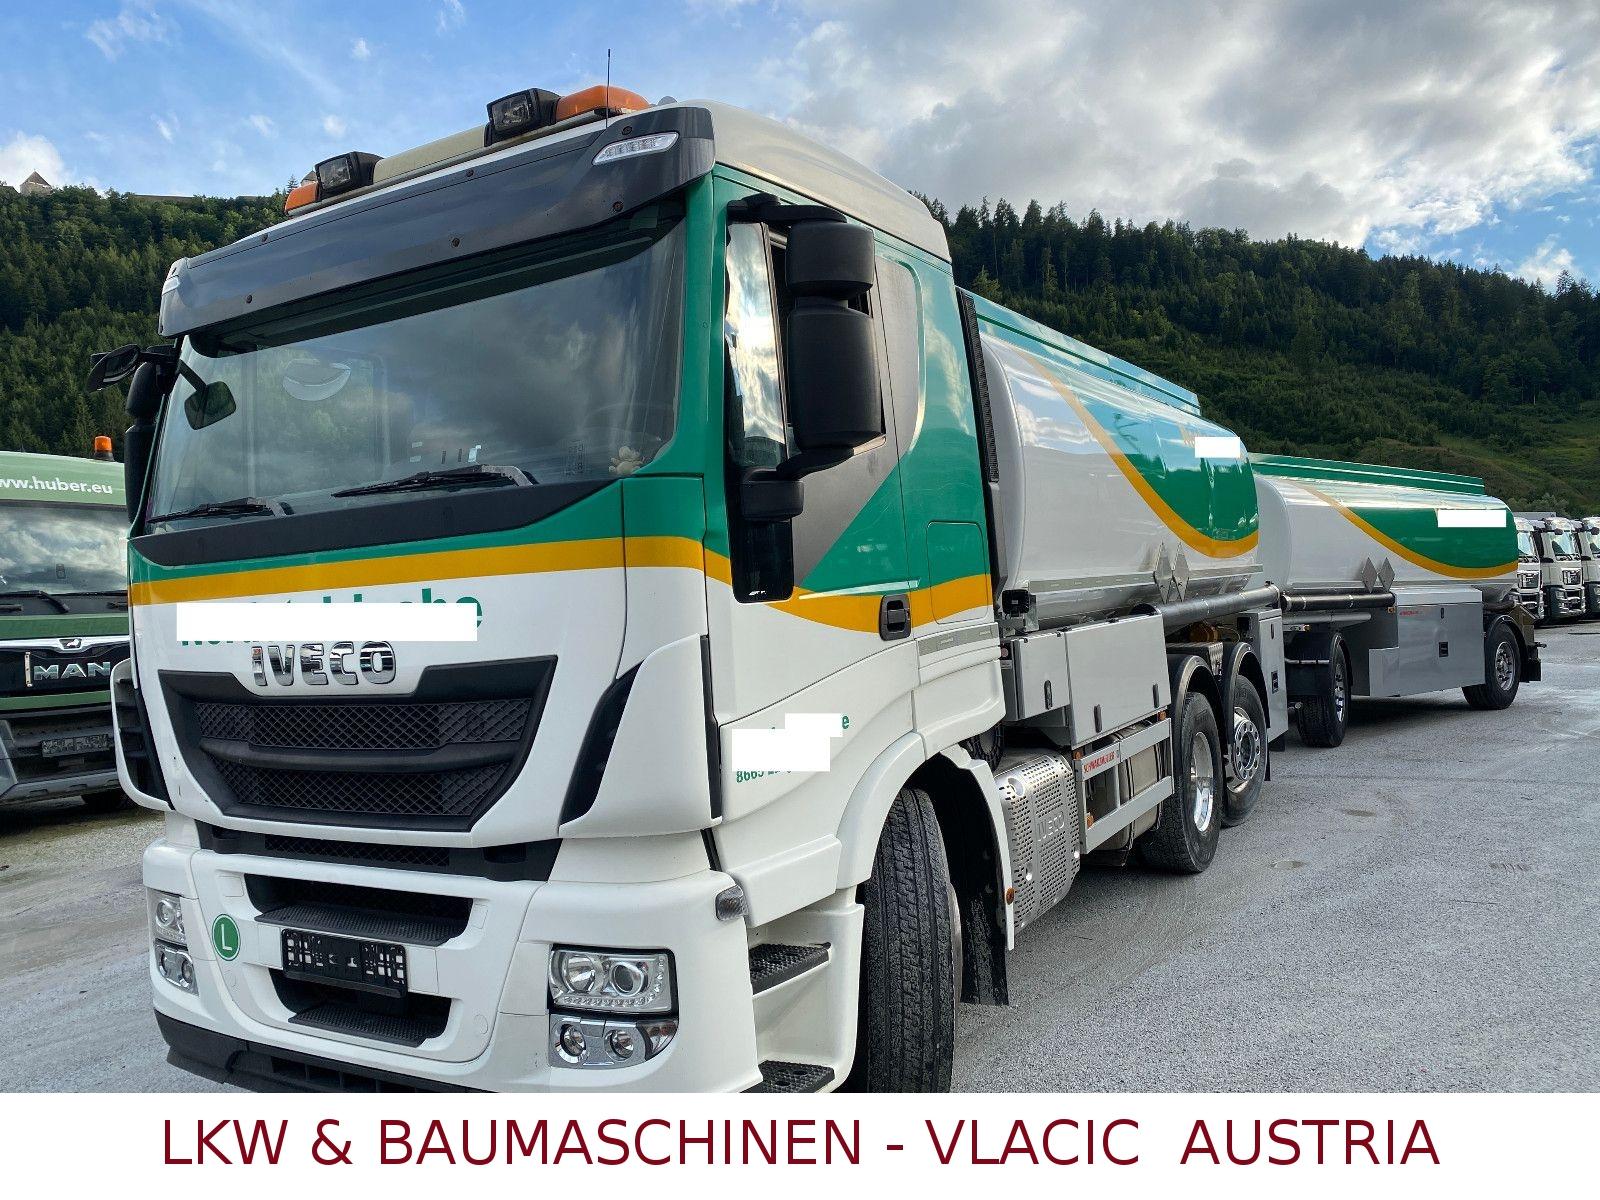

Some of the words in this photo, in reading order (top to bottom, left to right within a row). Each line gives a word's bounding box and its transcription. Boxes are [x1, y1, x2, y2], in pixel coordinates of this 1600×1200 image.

[33, 661, 111, 681] MAN
[250, 641, 397, 687] IVECO
[220, 923, 233, 951] L
